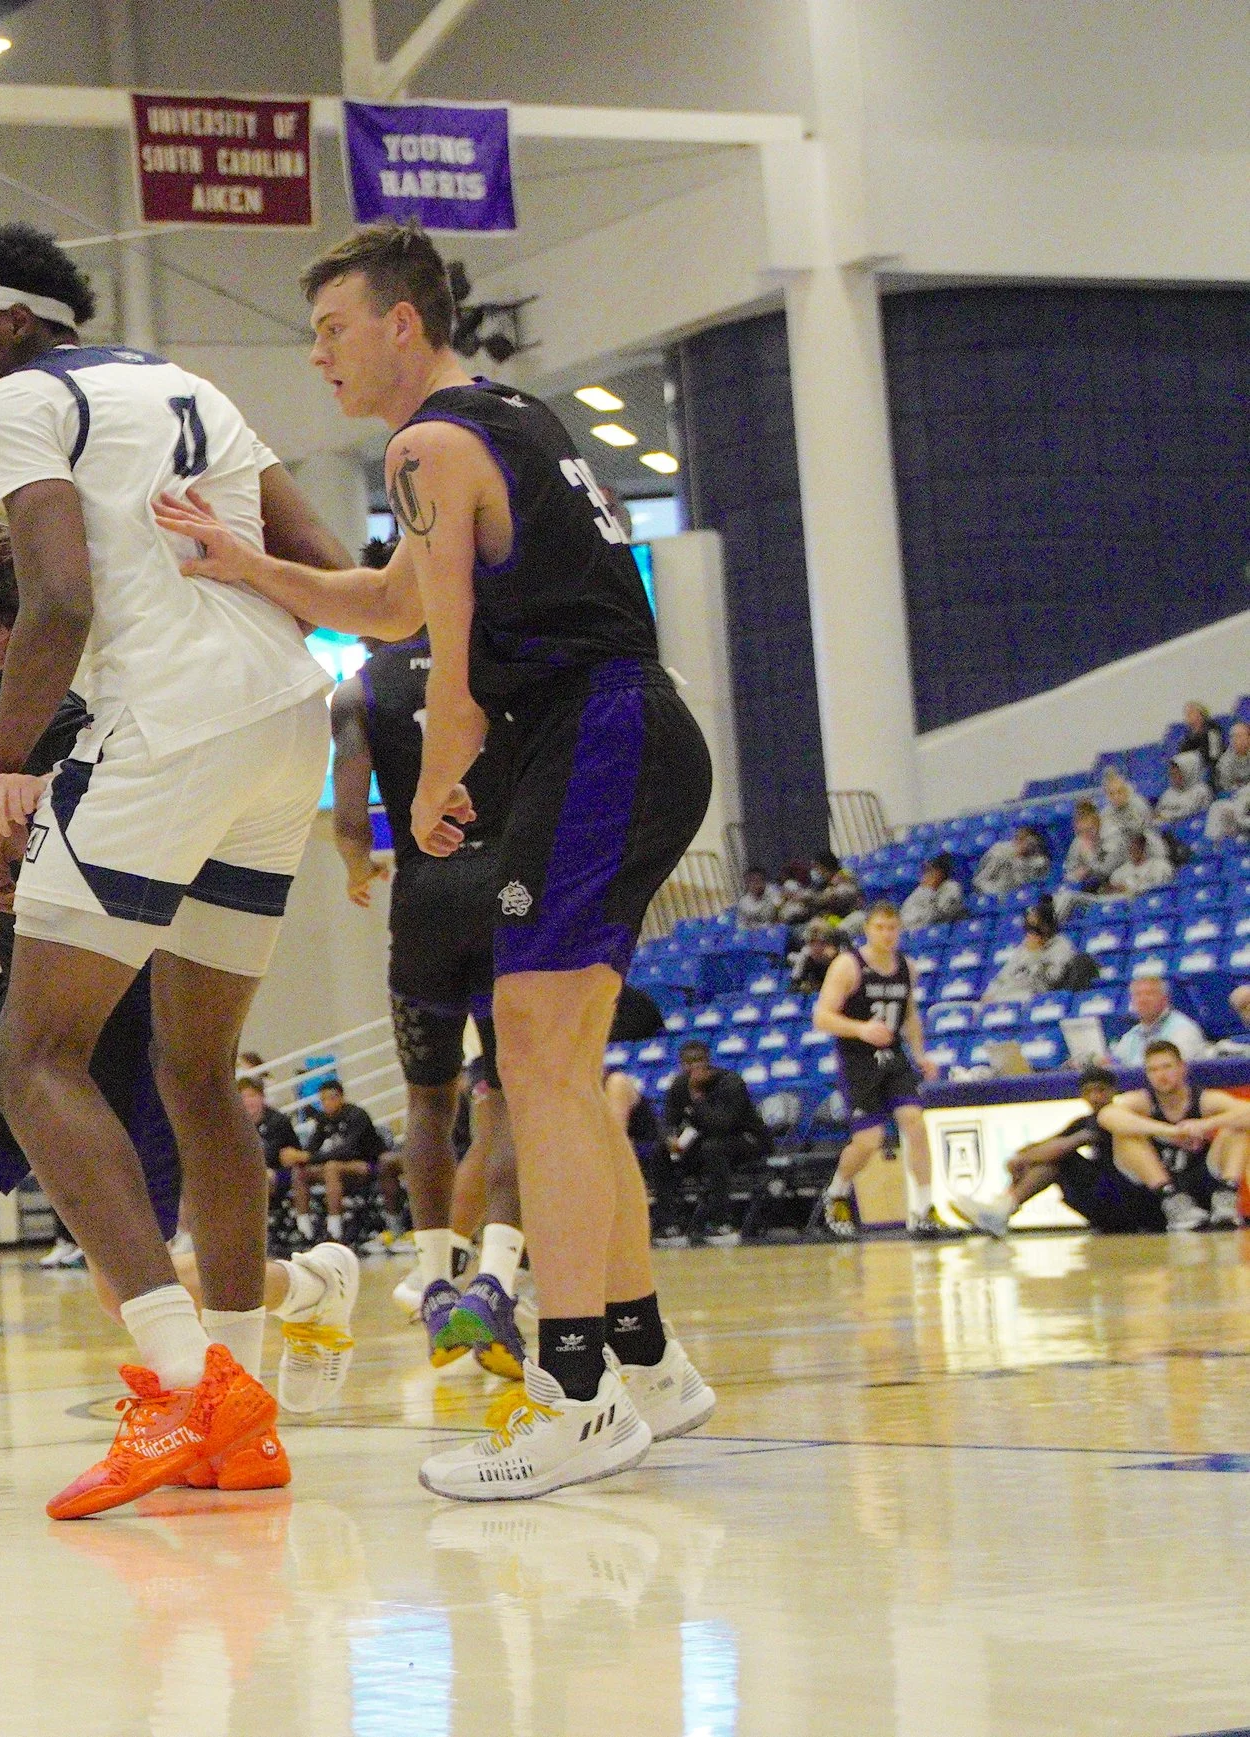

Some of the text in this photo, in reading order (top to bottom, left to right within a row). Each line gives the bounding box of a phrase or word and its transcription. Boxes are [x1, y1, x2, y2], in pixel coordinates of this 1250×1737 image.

[381, 133, 476, 166] YOUNG
[378, 169, 487, 201] HARRIS
[166, 395, 209, 479] 0
